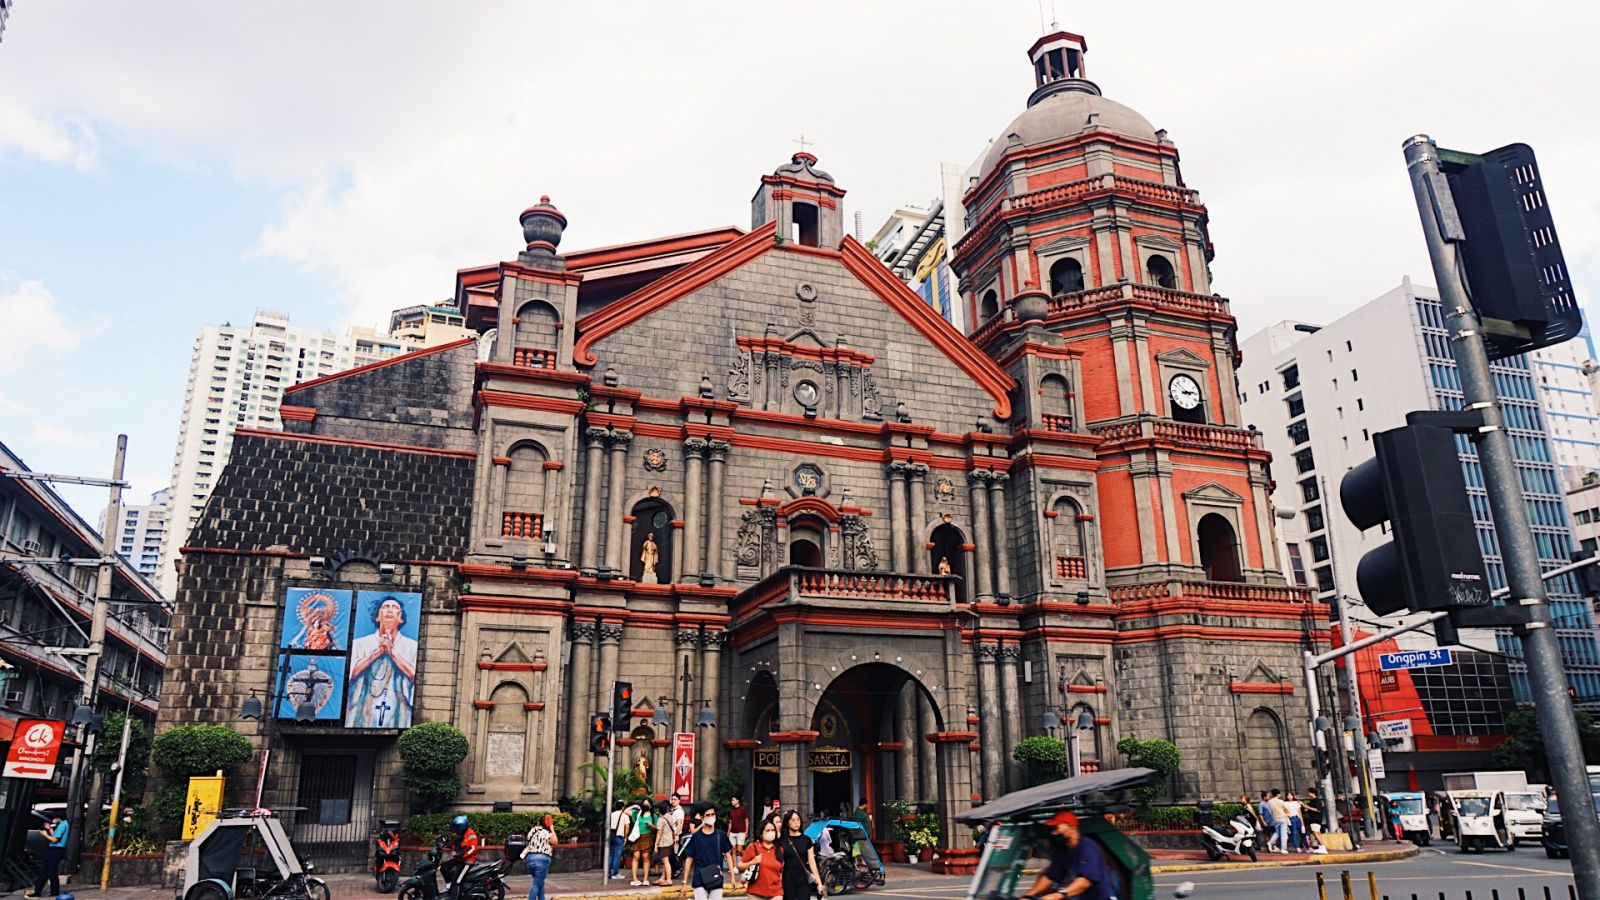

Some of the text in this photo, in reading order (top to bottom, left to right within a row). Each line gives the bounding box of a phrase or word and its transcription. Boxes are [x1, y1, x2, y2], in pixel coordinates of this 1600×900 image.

[1388, 650, 1442, 665] Ongpin St
[1381, 676, 1395, 685] AUB
[808, 753, 847, 765] SANCTA
